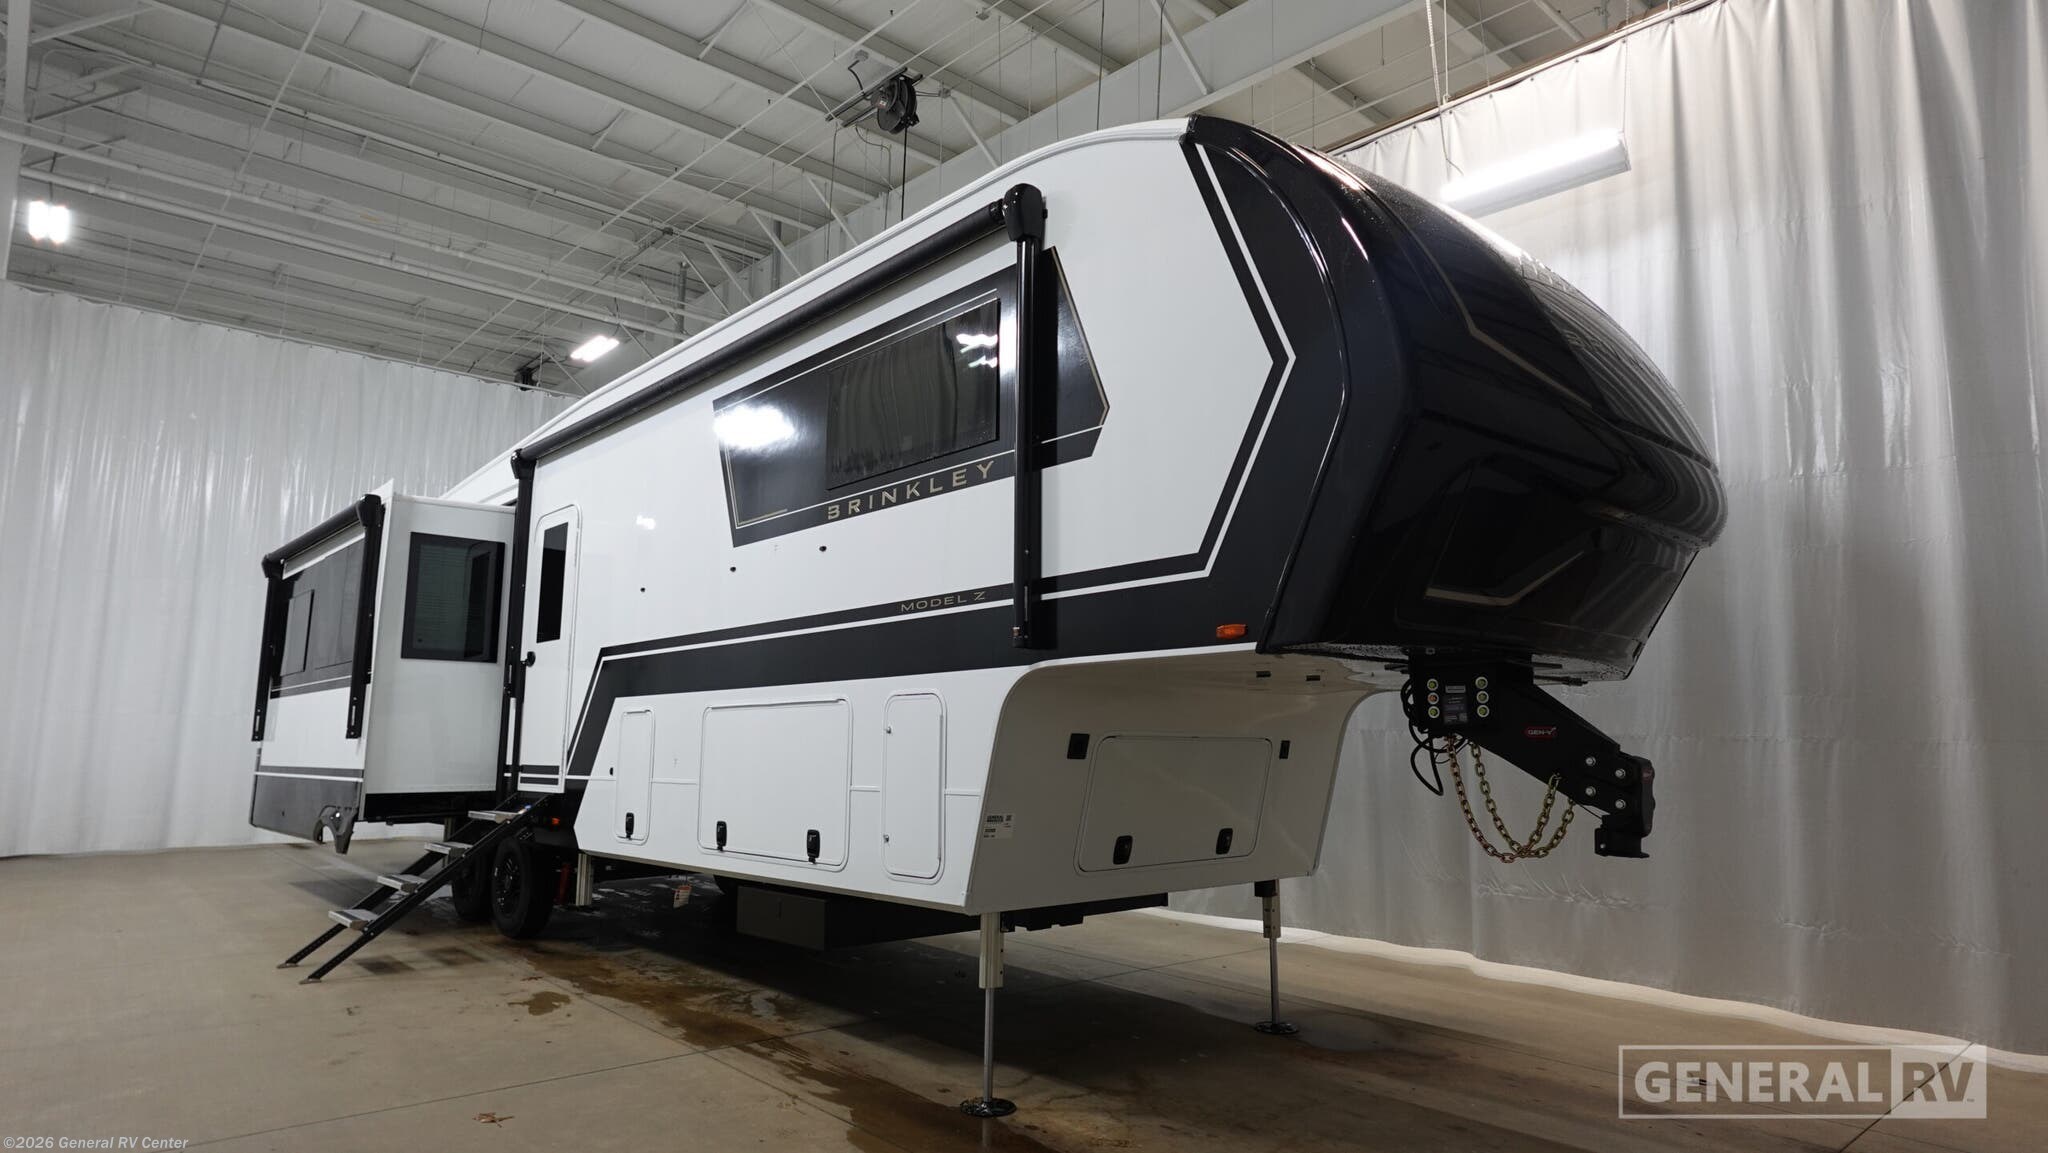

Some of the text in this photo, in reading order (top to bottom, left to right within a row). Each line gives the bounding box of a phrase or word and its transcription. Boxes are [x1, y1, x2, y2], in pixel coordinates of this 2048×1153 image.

[828, 461, 993, 519] BRINKLEY
[901, 591, 985, 612] MODEL Z
